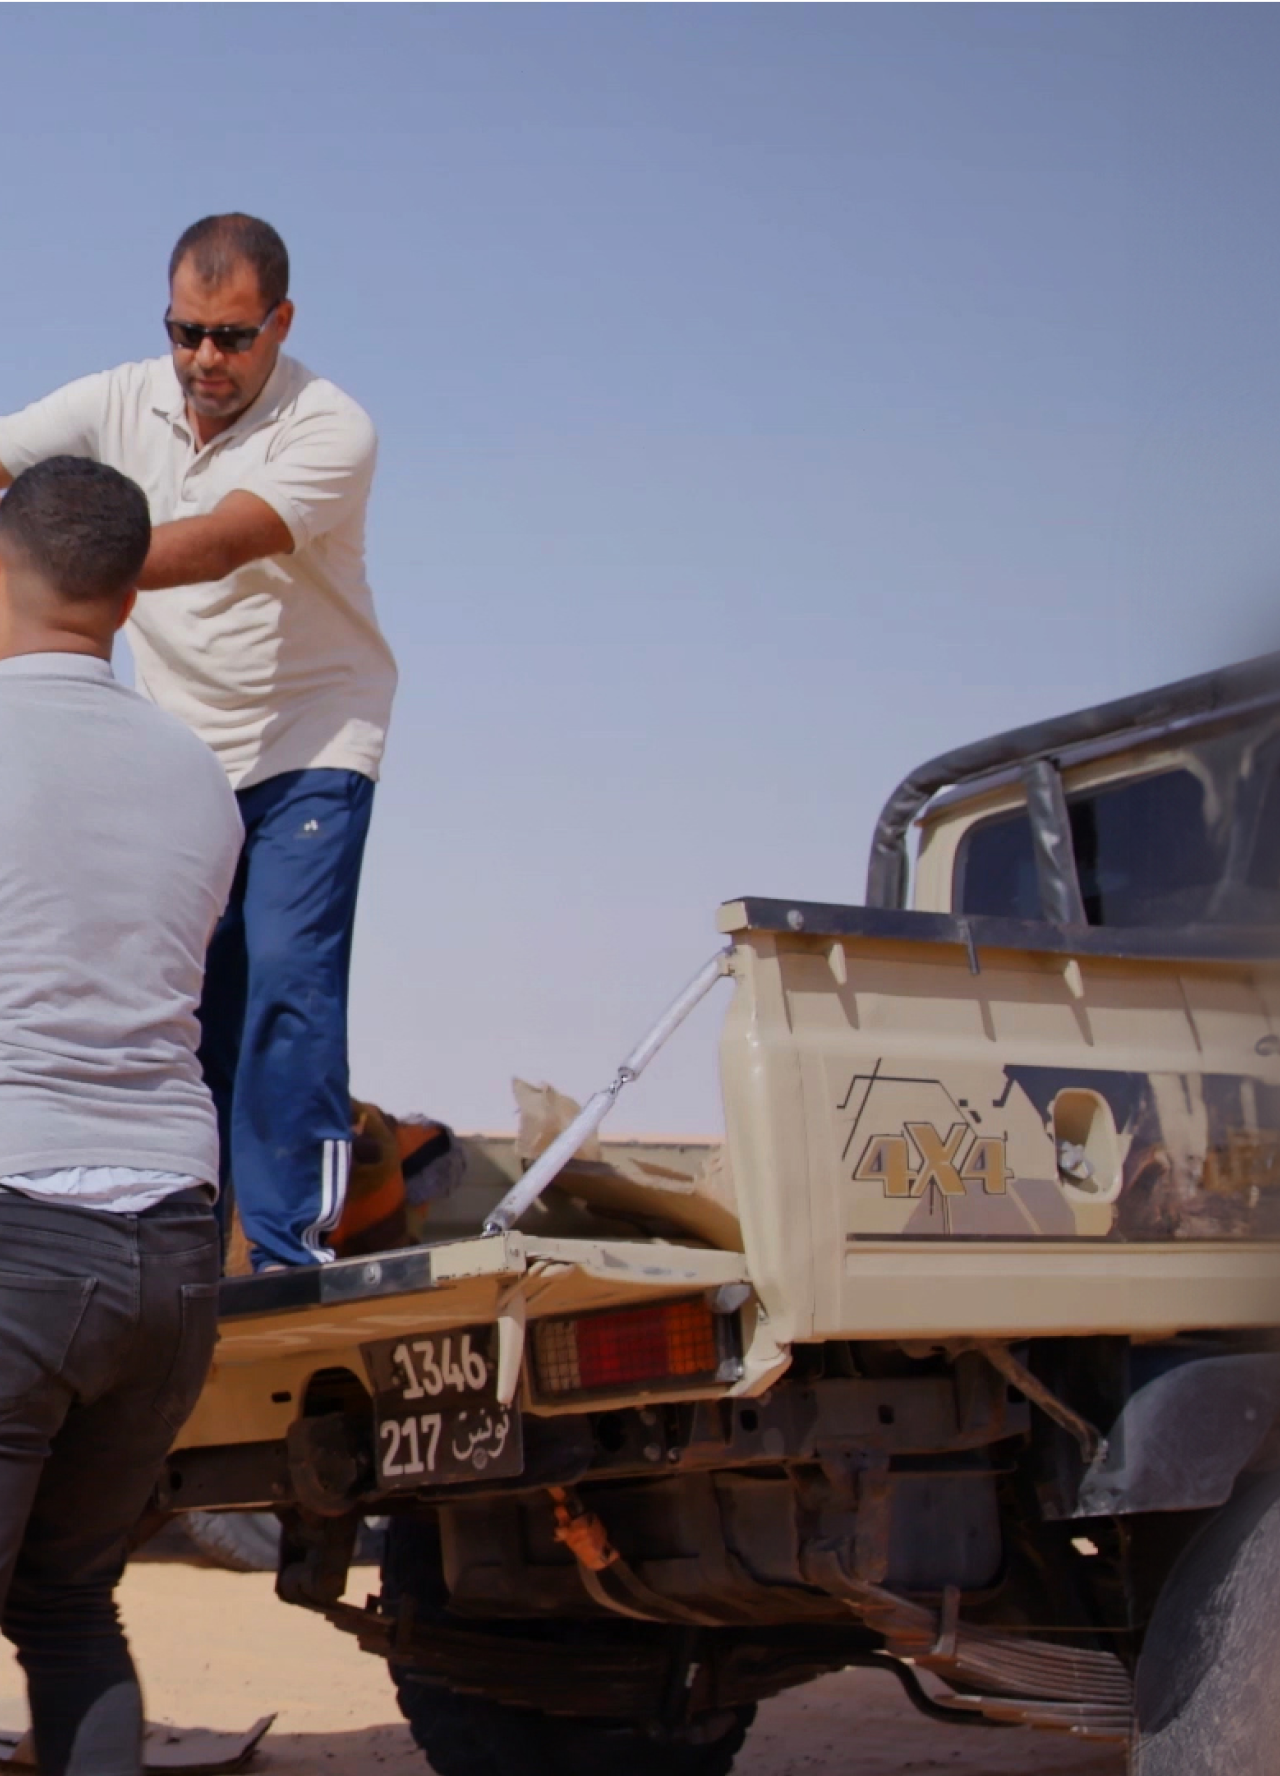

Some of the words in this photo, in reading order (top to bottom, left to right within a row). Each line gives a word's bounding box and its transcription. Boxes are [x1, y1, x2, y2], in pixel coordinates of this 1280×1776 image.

[852, 1122, 1014, 1198] 4X4
[393, 1334, 487, 1400] 1346
[379, 1412, 442, 1477] 217
[452, 1403, 511, 1461] تونس
